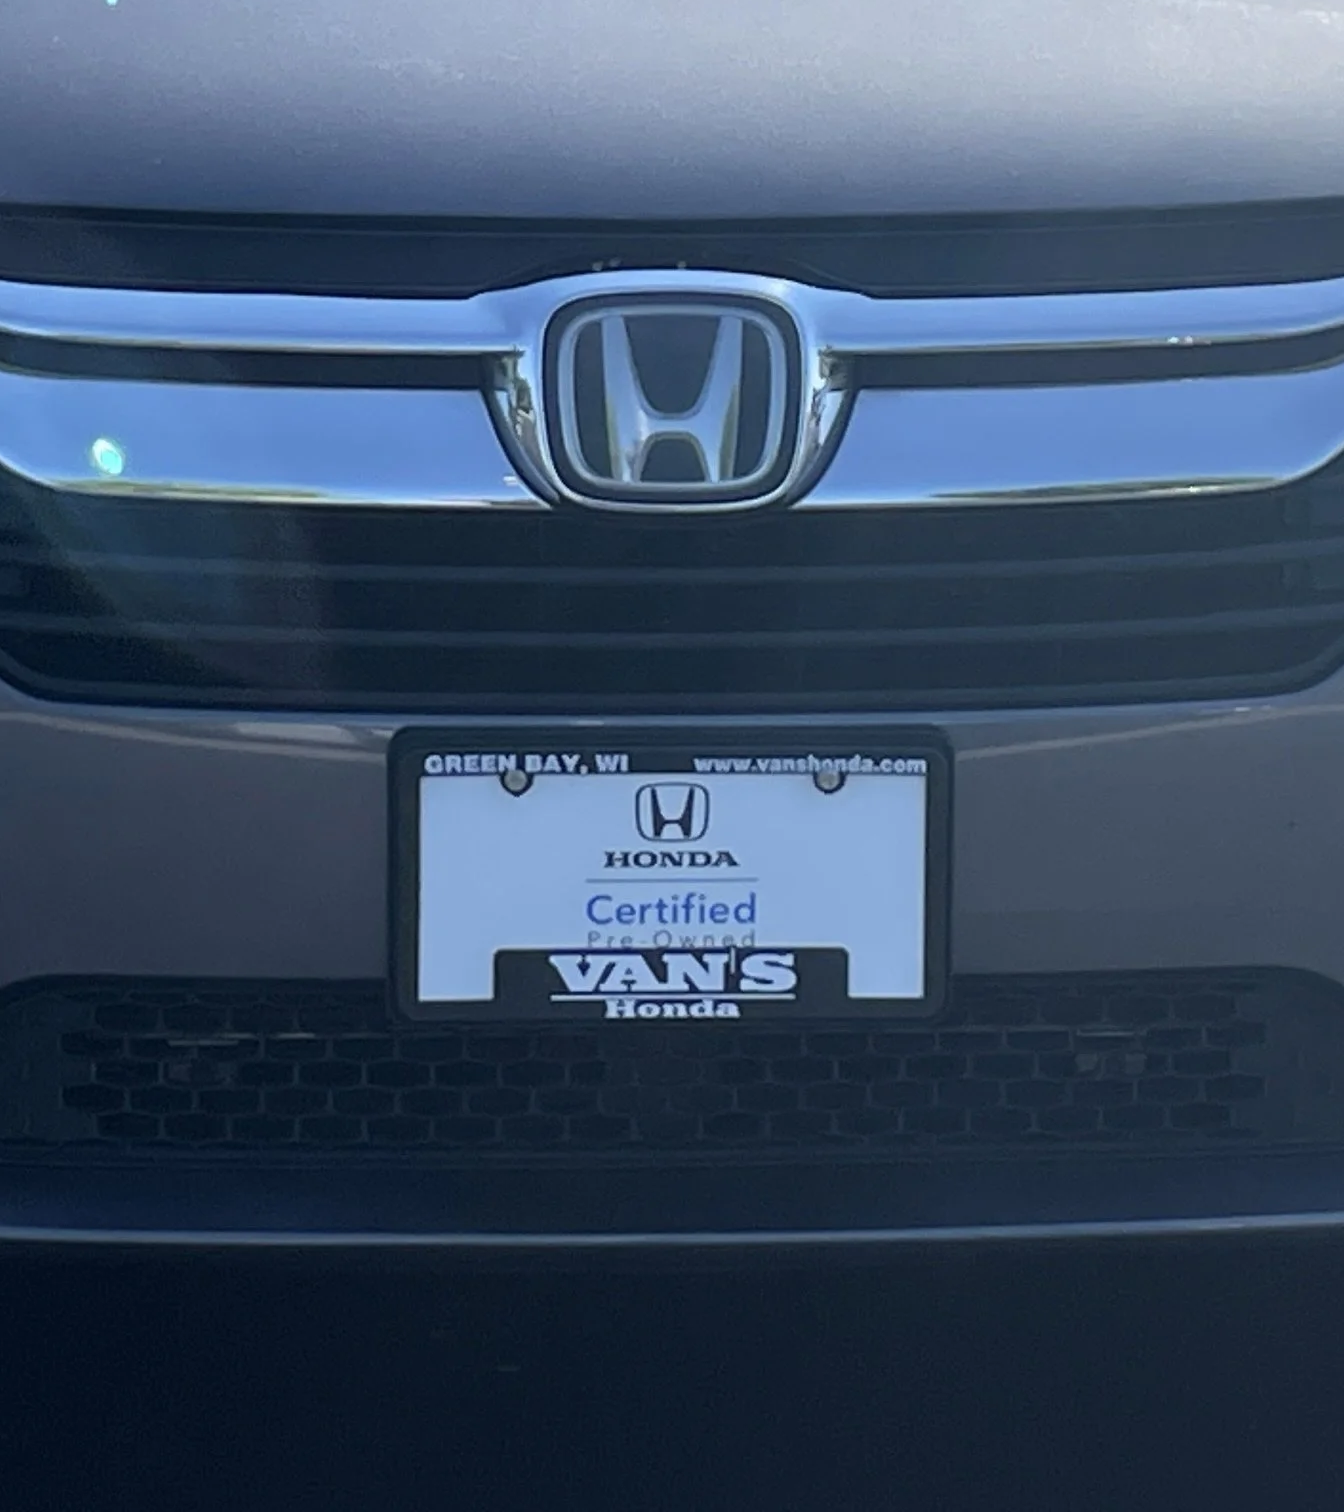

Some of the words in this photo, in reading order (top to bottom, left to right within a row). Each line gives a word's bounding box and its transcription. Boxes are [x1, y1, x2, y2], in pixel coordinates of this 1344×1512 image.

[424, 754, 517, 773] GREEN
[595, 754, 629, 772] WI
[693, 753, 926, 773] www.vanshonda.com
[603, 850, 740, 869] HONDA
[586, 892, 756, 925] Certified
[587, 930, 755, 949] Pre-Owned
[548, 947, 798, 992] VAN'S
[604, 998, 741, 1019] Honda
